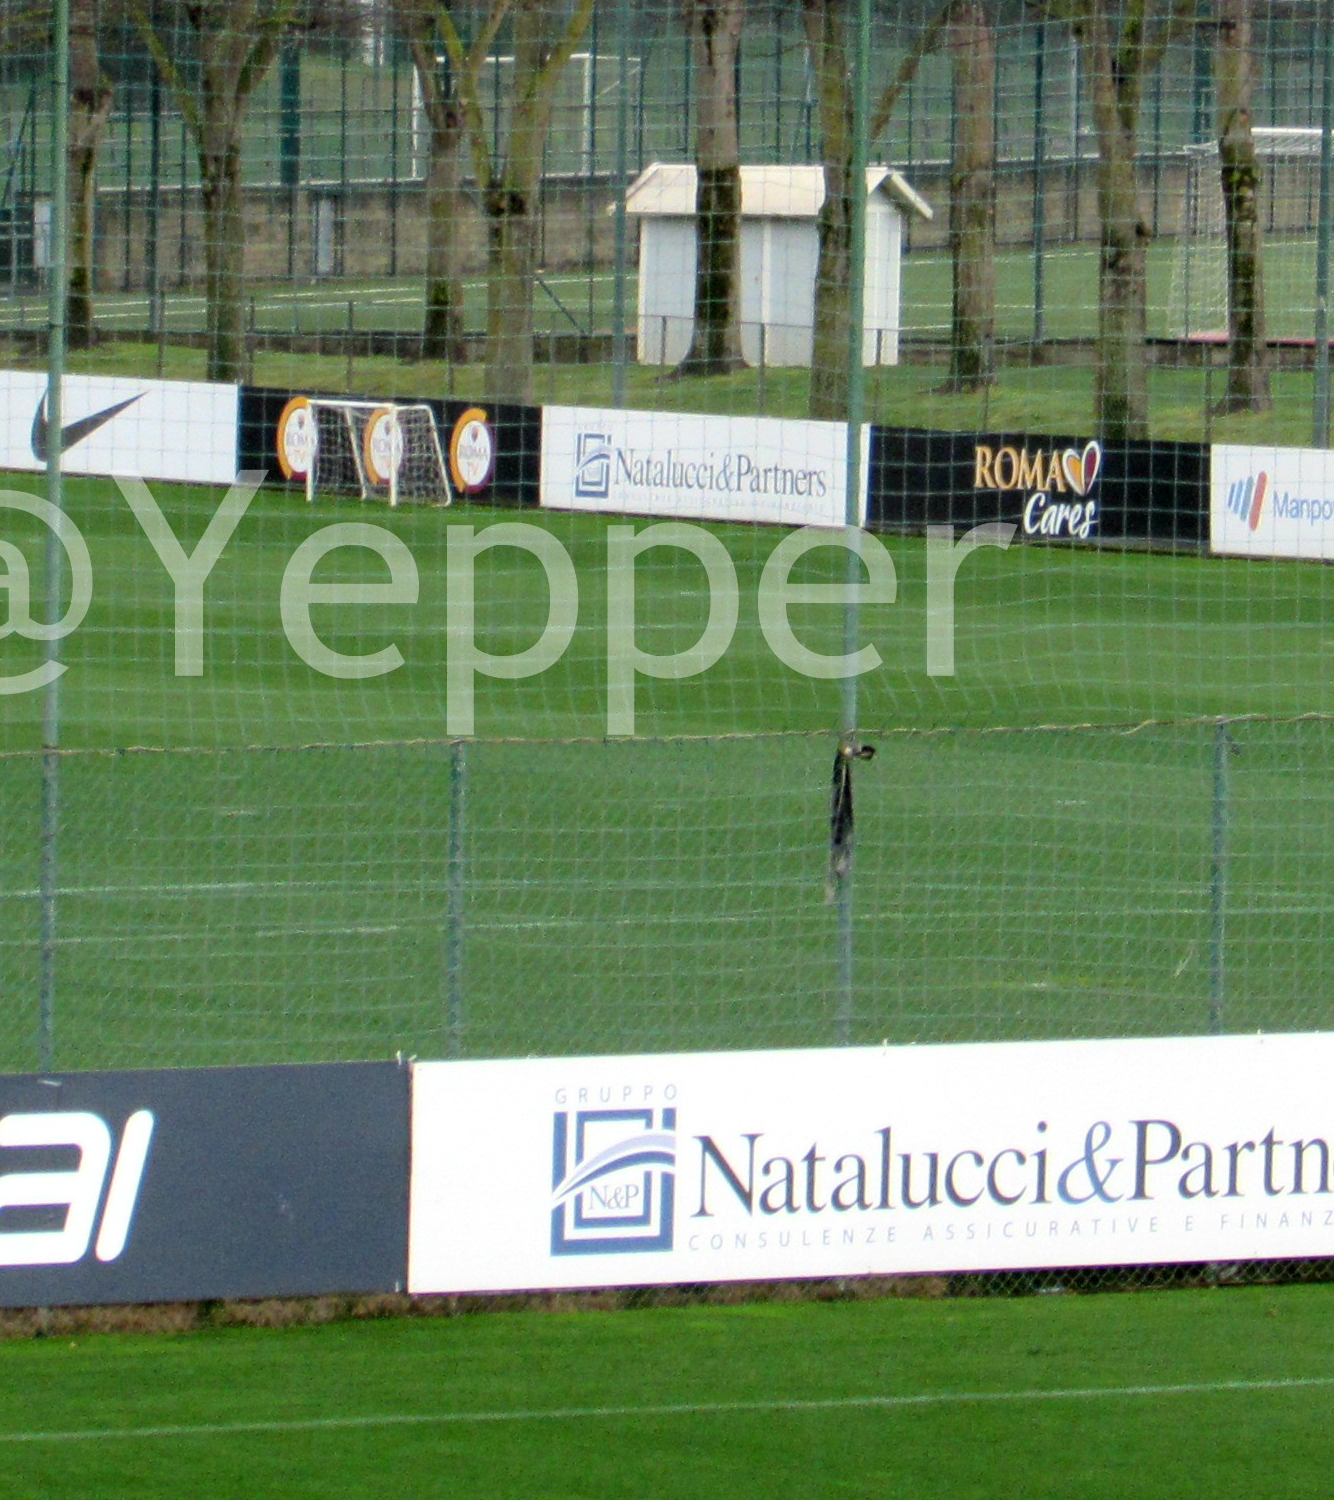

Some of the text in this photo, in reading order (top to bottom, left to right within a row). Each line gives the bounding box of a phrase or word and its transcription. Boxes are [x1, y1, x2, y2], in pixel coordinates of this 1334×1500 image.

[974, 445, 1067, 492] ROMA
[1023, 492, 1099, 539] Cares
[554, 1083, 679, 1105] GRUPPO
[588, 1184, 640, 1211] N&P
[688, 1226, 898, 1252] CONSULENZE
[922, 1215, 1159, 1242] ASSICURATIVE
[1183, 1214, 1195, 1232] E
